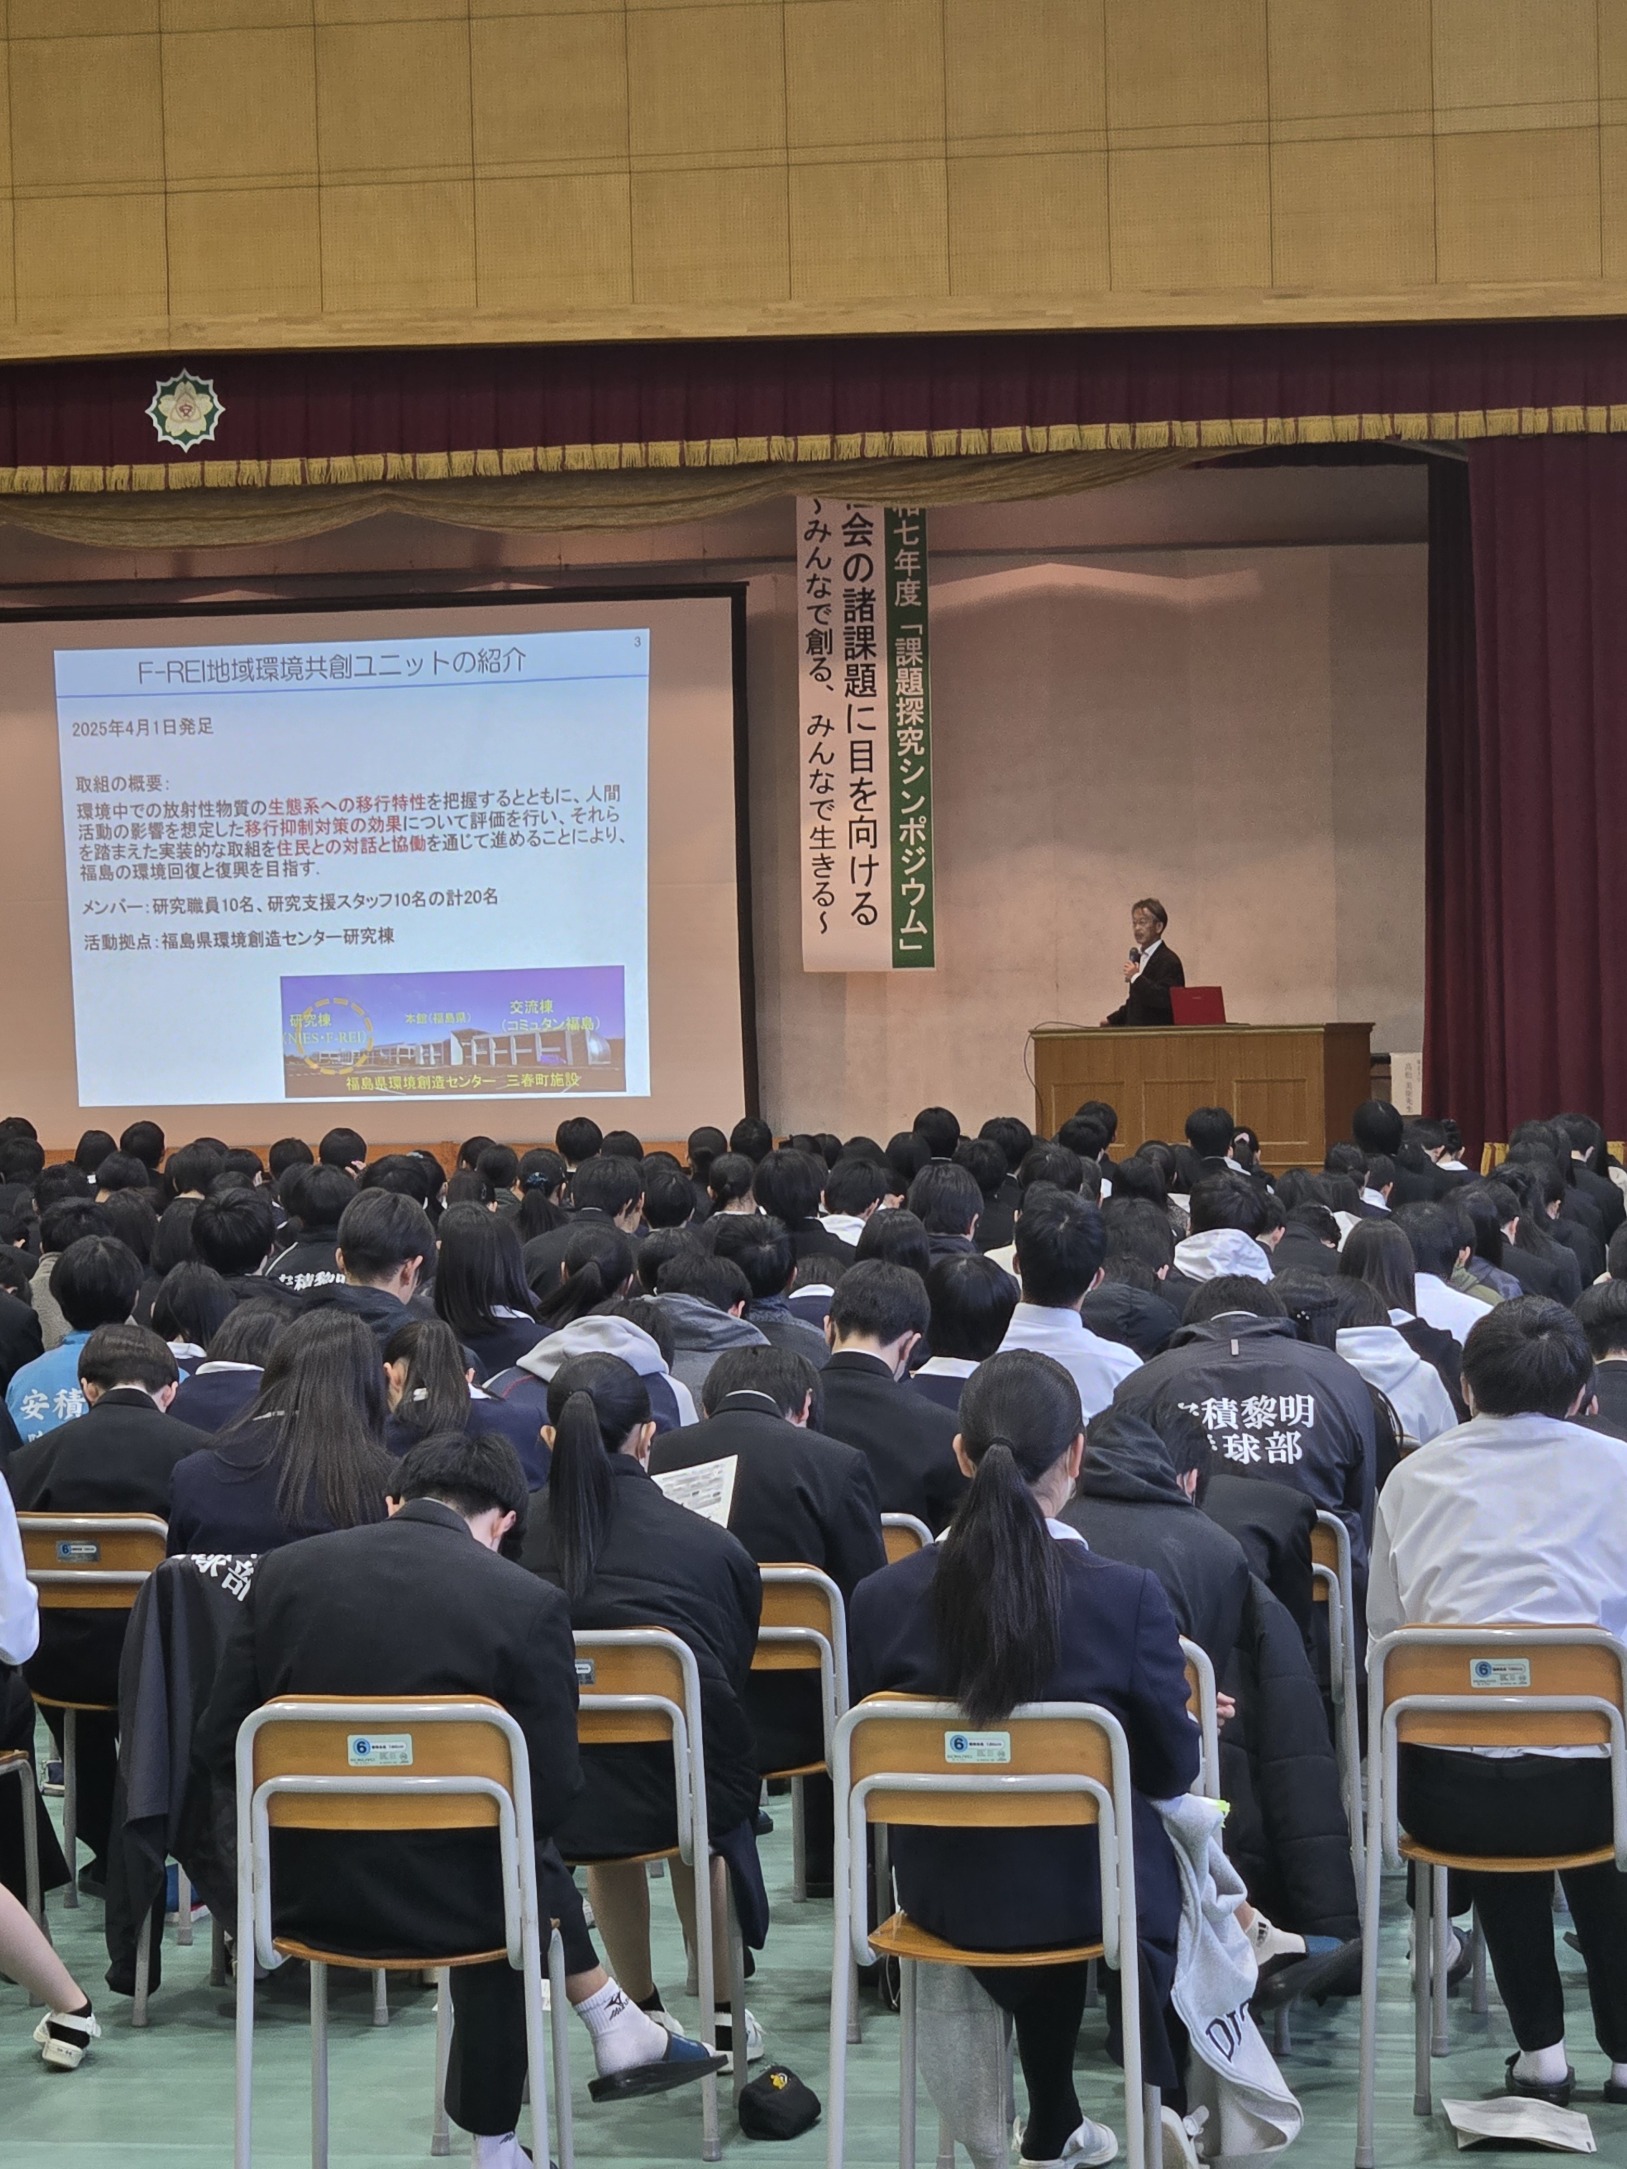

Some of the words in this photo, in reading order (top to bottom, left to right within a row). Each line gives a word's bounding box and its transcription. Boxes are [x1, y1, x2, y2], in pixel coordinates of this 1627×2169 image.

[633, 636, 642, 648] 3
[138, 646, 527, 684] F-REI地域環境共創ユニットの紹介
[72, 717, 214, 738] 2025年4月1日発足
[841, 504, 880, 926] 会の諸課題に目を向ける
[75, 774, 170, 794] 取組の概要:
[77, 784, 621, 821] 環境中での放射性物質の生態系への移行特性を把握するとともに、人間
[78, 805, 620, 842] 活動の影響を想定した移行抑制対策の効果について評価を行い、それら
[79, 826, 626, 862] を踏まえた実装的な取組を住民との対話と協働を通じて進めることにより、
[510, 1000, 554, 1014] 交流棟
[346, 1074, 497, 1091] 福島県環境創造センター
[506, 1072, 580, 1088] 三春町施設
[20, 1388, 86, 1421] 安積
[1177, 1394, 1315, 1431] 積黎明
[1206, 1430, 1303, 1465] 球部
[1478, 1663, 1489, 1676] 6
[356, 1740, 367, 1754] 6
[953, 1737, 965, 1751] 6
